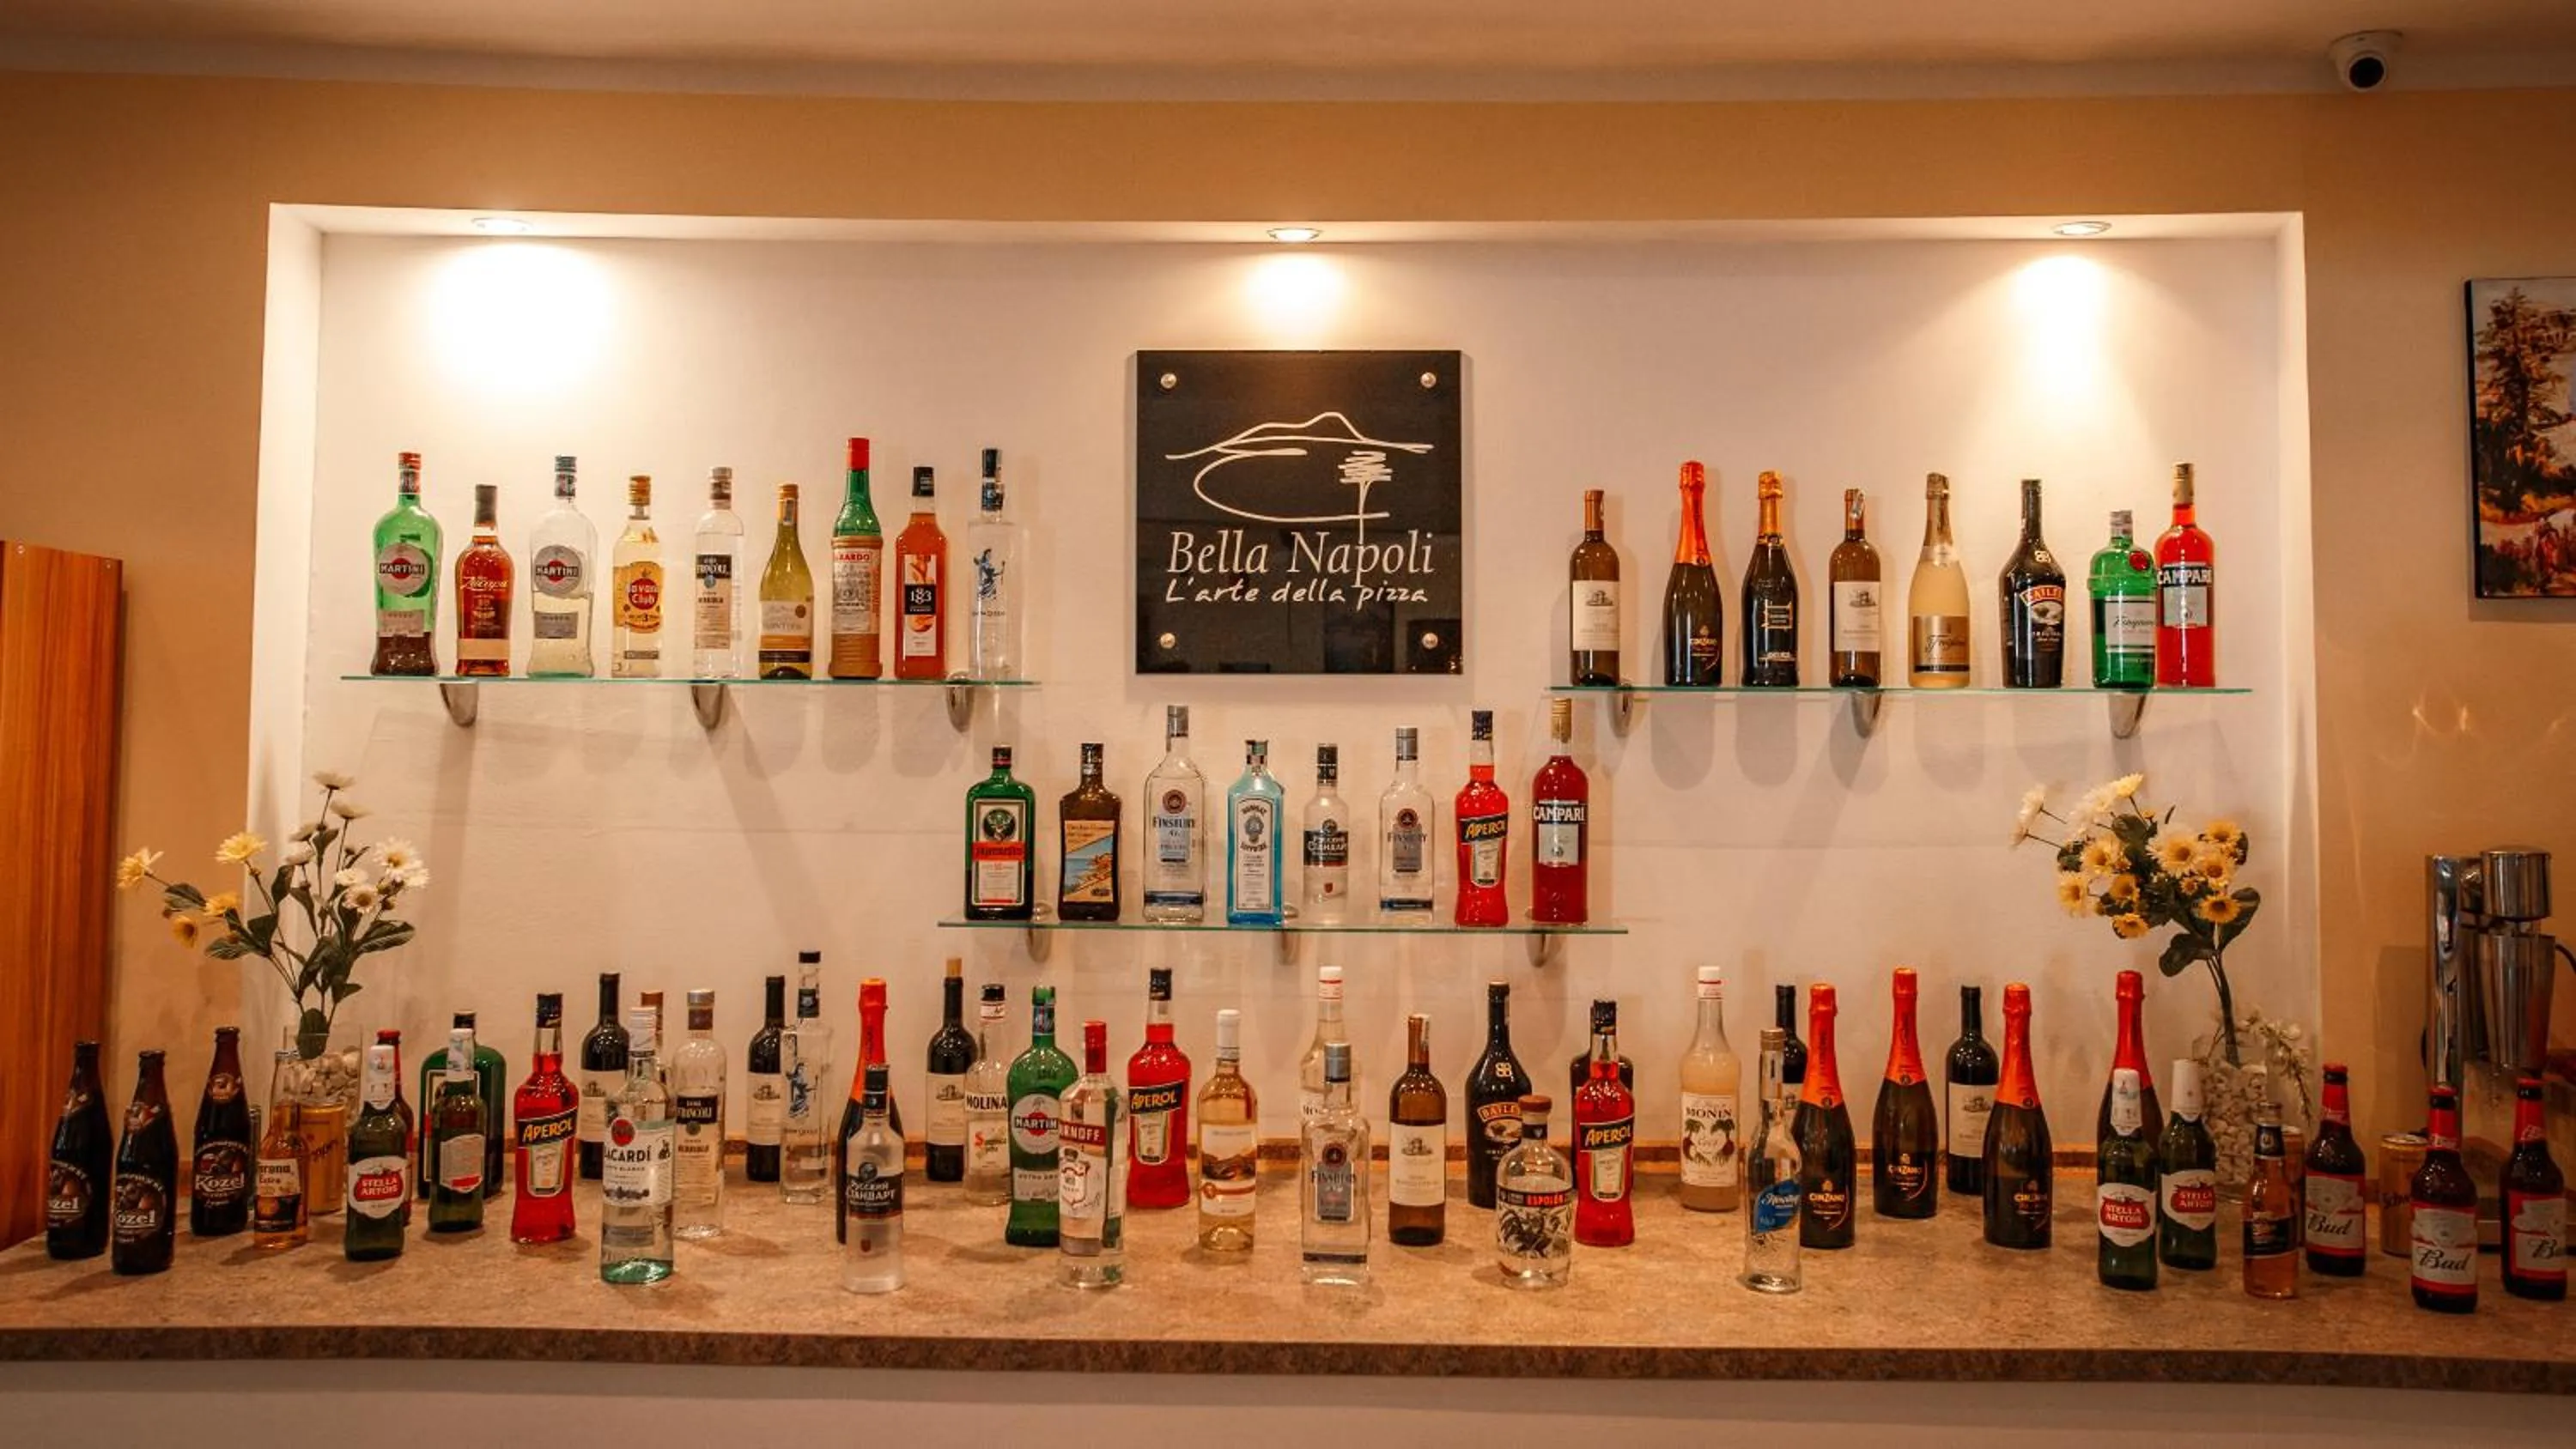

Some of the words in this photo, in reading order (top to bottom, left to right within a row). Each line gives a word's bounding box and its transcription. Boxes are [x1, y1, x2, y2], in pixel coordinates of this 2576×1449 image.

[1167, 530, 1268, 573] Bella
[1286, 530, 1435, 588] Napoli
[380, 563, 425, 575] MARTINI
[1165, 578, 1260, 602] L'arte
[1272, 579, 1346, 602] della
[1358, 580, 1428, 610] pizza
[1534, 806, 1585, 822] CAMPARI
[967, 1095, 1006, 1109] MOLINA
[1132, 1090, 1177, 1110] APEROL
[1686, 1106, 1731, 1119] MONIN
[522, 1118, 573, 1143] APEROL
[1585, 1125, 1631, 1147] APEROL
[194, 1174, 245, 1191] Kozel
[361, 1177, 398, 1188] STELLA
[361, 1185, 398, 1196] ARTOIS
[2105, 1203, 2142, 1215] STELLA
[2307, 1213, 2354, 1235] Bud
[2417, 1246, 2472, 1271] Bud
